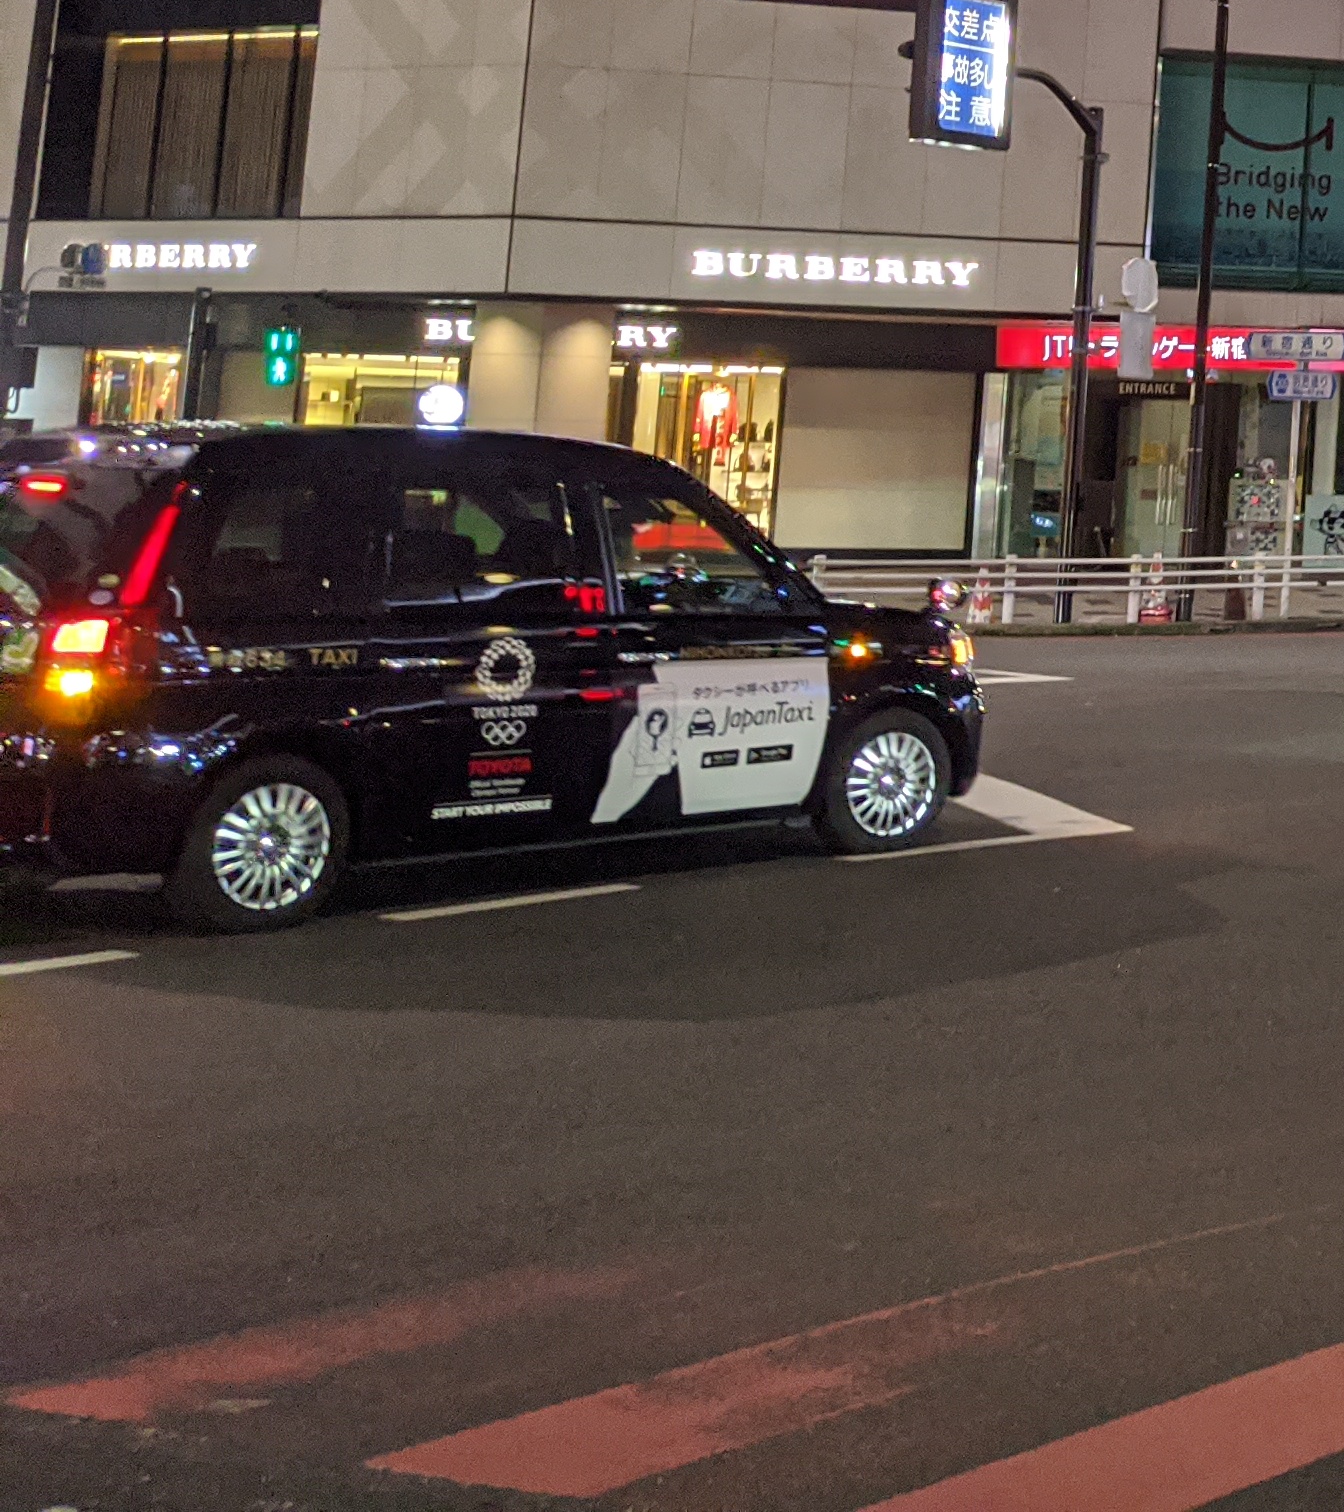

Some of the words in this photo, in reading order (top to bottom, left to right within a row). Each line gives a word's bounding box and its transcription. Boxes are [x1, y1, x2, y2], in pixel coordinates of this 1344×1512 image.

[943, 6, 1010, 43] 交差点
[938, 88, 1002, 126] 注意
[1213, 163, 1332, 196] Bridging
[1214, 194, 1257, 219] the
[1266, 198, 1329, 223] New
[104, 243, 257, 269] RBERRY
[691, 250, 979, 286] BURBERRY
[1260, 335, 1333, 350] 新宿通り
[1119, 382, 1176, 395] ENTRANCE
[308, 647, 358, 667] TAXI
[692, 679, 809, 700] タクシーが呼べるアプリ
[471, 706, 510, 720] TOKYO
[511, 704, 539, 718] 2020
[718, 700, 815, 737] JapanTaxi
[468, 757, 533, 777] TOYOTA
[431, 806, 465, 820] START
[465, 803, 494, 817] YOUR
[494, 799, 553, 814] IMPOSSIBLE
